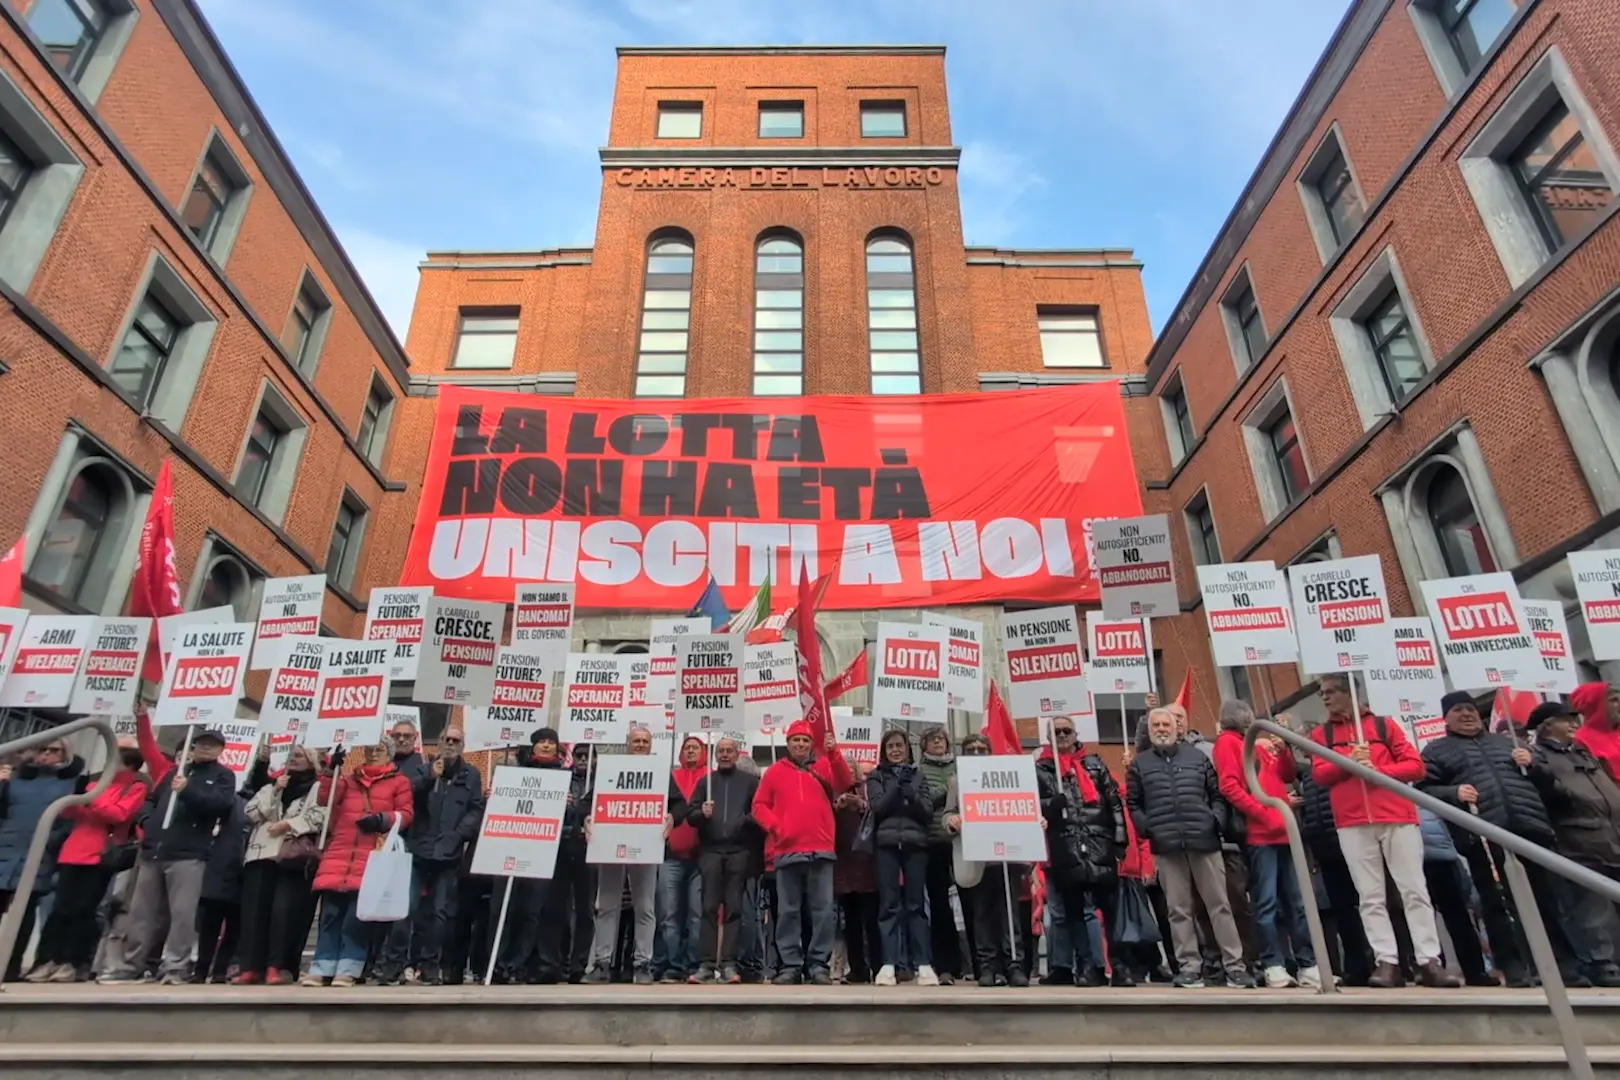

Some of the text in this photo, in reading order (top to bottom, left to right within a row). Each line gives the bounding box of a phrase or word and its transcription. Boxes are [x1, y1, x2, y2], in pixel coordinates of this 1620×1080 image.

[616, 167, 943, 188] CAMERA DEL LAVORO
[451, 404, 825, 462] LA LOTTA
[438, 448, 932, 520] NON HA ETÀ
[1119, 525, 1140, 538] NON
[1097, 534, 1166, 550] AUTOSUFFICIENTI?
[428, 518, 818, 587] UNISCITI
[838, 524, 902, 585] A
[917, 517, 1074, 581] NOI
[1123, 548, 1143, 563] NO.
[1102, 566, 1170, 584] ABBANDONATI.
[1227, 570, 1248, 582] NON
[1303, 569, 1351, 584] IL CARRELLO
[286, 583, 303, 593] NON
[1205, 580, 1276, 594] AUTOSUFFICIENTI?
[1304, 577, 1376, 603] CRESCE,
[1461, 584, 1476, 594] CHI
[264, 592, 321, 604] AUTOSUFFICIENTI?
[383, 593, 419, 604] PENSIONI
[521, 592, 568, 603] NON SIAMO IL
[1232, 593, 1254, 608] NO.
[282, 603, 298, 617] NO.
[377, 605, 421, 619] FUTURE?
[437, 606, 480, 619] IL CARRELLO
[518, 609, 570, 624] BANCOMAT
[1308, 604, 1382, 625] LE PENSIONI
[1442, 602, 1515, 632] LOTTA
[1212, 612, 1284, 628] ABBANDONATI.
[103, 624, 138, 635] PENSIONI
[370, 623, 422, 640] SPERANZE
[435, 616, 494, 641] CRESCE,
[516, 629, 568, 640] DEL GOVERNO.
[673, 625, 689, 634] NON
[969, 631, 976, 641] IL
[1006, 618, 1072, 639] IN PENSIONE
[1334, 628, 1356, 643] NO!
[1416, 627, 1424, 638] IL
[39, 629, 76, 645] ARMI
[96, 636, 138, 650] FUTURE?
[183, 632, 245, 647] LA SALUTE
[1024, 635, 1056, 646] MA NON IN
[1097, 630, 1142, 650] LOTTA
[197, 648, 210, 656] NON
[433, 636, 494, 662] LE PENSIONI
[691, 641, 729, 652] PENSIONI
[1444, 636, 1533, 656] NON INVECCHIA!
[24, 654, 79, 669] WELFARE
[329, 649, 387, 666] LA SALUTE
[500, 653, 540, 666] PENSIONI
[687, 653, 733, 668] FUTURE?
[757, 649, 773, 660] NON
[886, 647, 937, 672] LOTTA
[87, 656, 138, 672] SPERANZE
[580, 660, 617, 670] PENSIONI
[1010, 651, 1078, 676] SILENZIO!
[1092, 658, 1108, 668] NON
[173, 666, 235, 690] LUSSO
[342, 667, 354, 675] NON
[360, 667, 368, 675] UN
[448, 664, 467, 679] NO!
[495, 665, 542, 682] FUTURE?
[575, 671, 620, 684] FUTURE?
[759, 668, 775, 682] NO.
[1370, 668, 1437, 680] DEL GOVERNO.
[85, 676, 127, 691] PASSATE.
[683, 673, 736, 689] SPERANZE
[877, 676, 945, 693] NON INVECCHIA!
[321, 686, 379, 710] LUSSO
[494, 685, 544, 703] PERANZE
[569, 689, 622, 703] SPERANZE
[275, 695, 313, 711] PASSA
[686, 695, 734, 709] PASSATE.
[487, 706, 536, 723] PASSATE.
[570, 708, 617, 722] PASSATE.
[224, 724, 257, 737] SALUTE
[845, 728, 870, 741] ARMI
[521, 776, 542, 787] NON
[616, 771, 653, 790] ARMI
[981, 770, 1020, 788] ARMI
[495, 786, 565, 800] AUTOSUFFICIENTI?
[515, 800, 536, 815] NO.
[606, 800, 662, 819] WELFARE
[975, 799, 1035, 816] WELFARE
[485, 819, 556, 837] ABBANDONATI.
